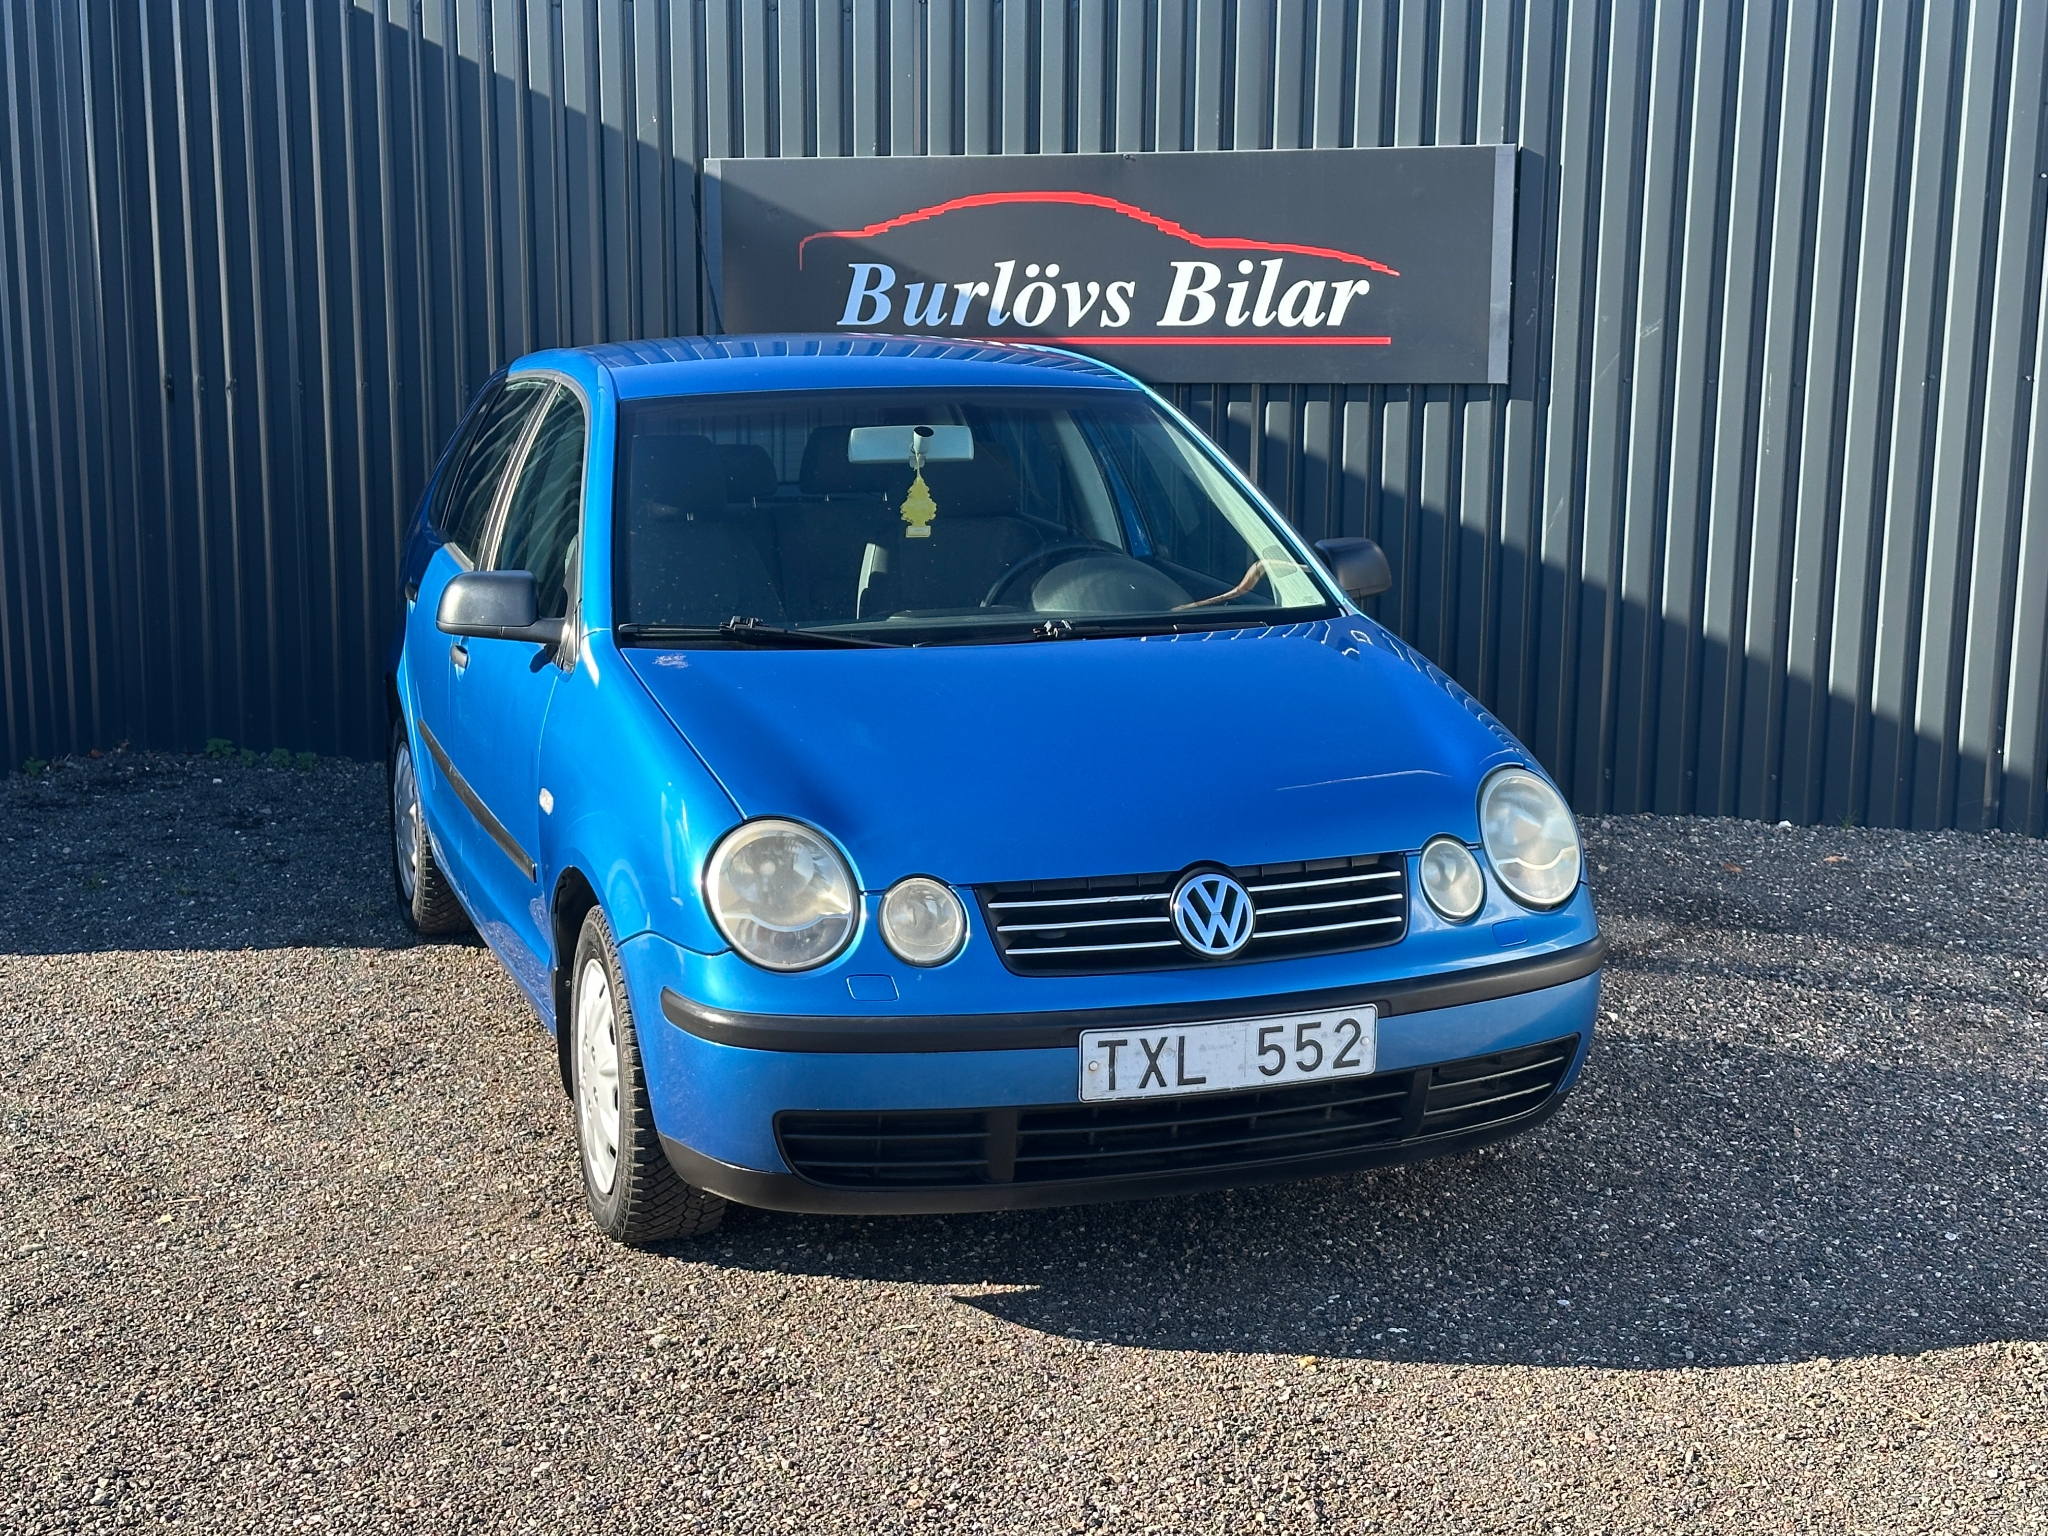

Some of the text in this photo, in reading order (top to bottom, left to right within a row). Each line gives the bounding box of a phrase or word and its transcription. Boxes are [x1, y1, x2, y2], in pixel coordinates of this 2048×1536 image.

[837, 257, 1371, 328] Burlövs Bilar
[1175, 873, 1254, 955] VW
[1097, 1018, 1362, 1091] TXL 552
